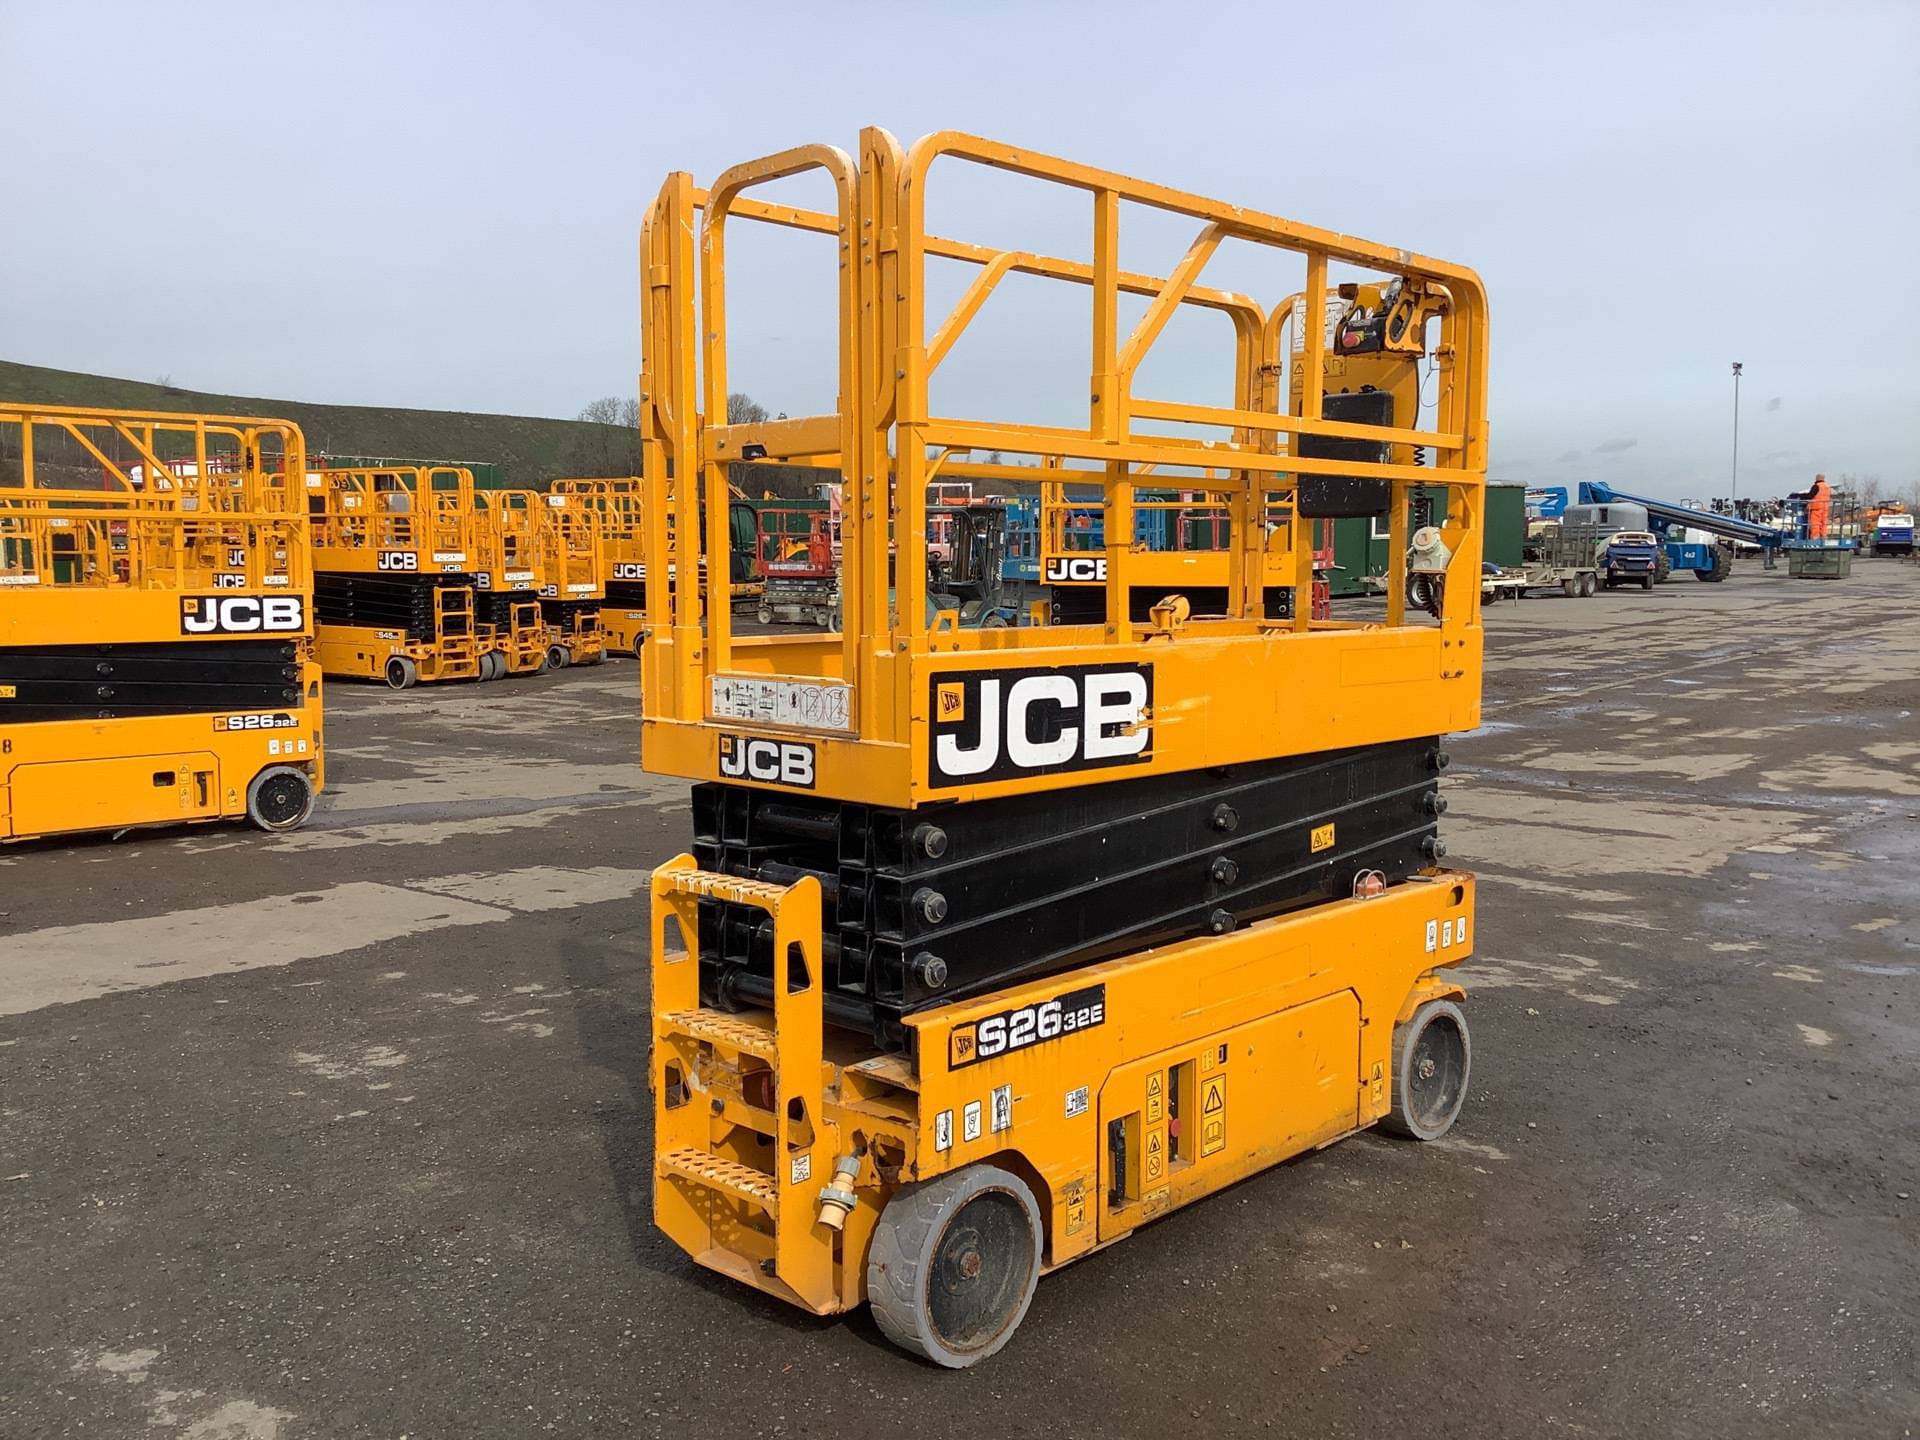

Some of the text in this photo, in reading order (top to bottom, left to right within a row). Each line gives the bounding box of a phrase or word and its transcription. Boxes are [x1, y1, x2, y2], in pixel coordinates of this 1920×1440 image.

[379, 552, 418, 570] JCB
[442, 564, 462, 572] JCB
[184, 598, 302, 632] JCB
[943, 691, 961, 712] JCB
[937, 671, 1148, 776] JCB
[721, 739, 814, 785] JCB
